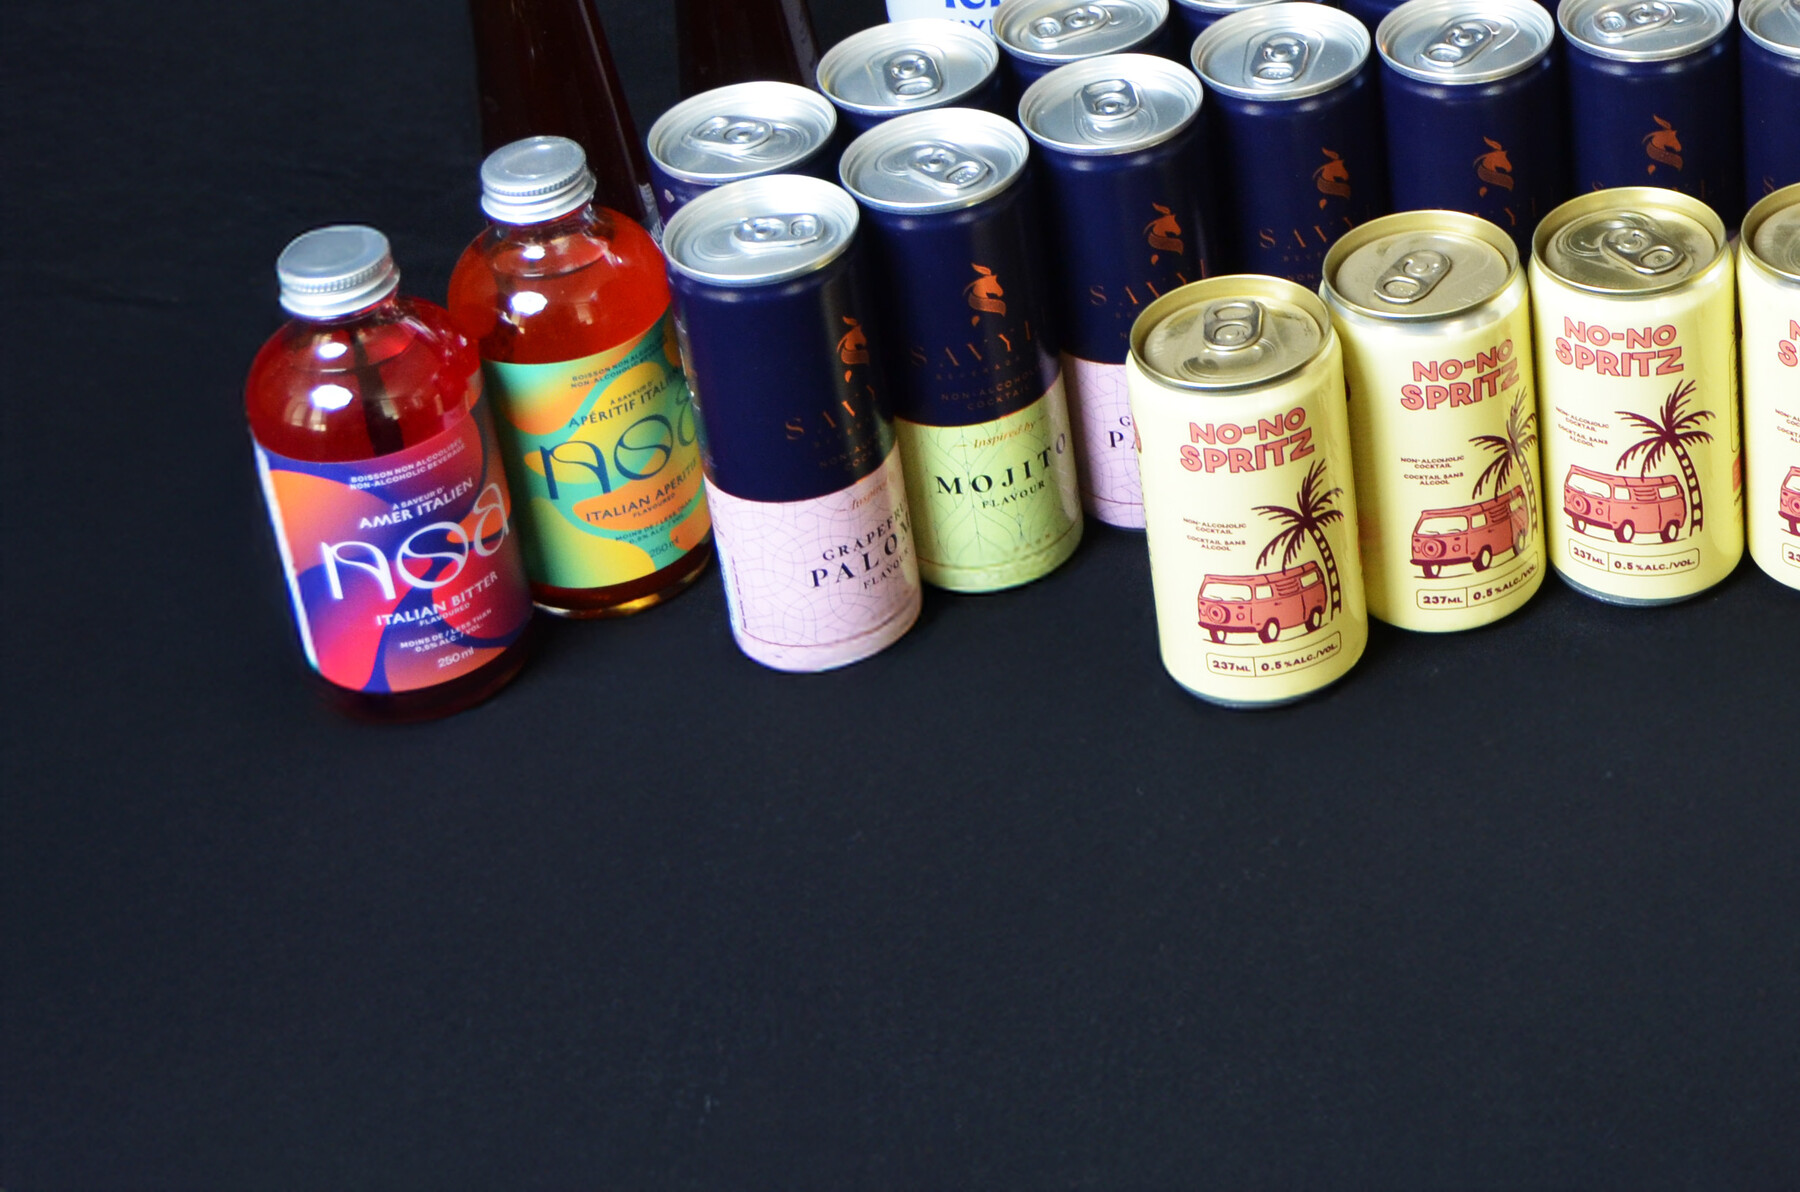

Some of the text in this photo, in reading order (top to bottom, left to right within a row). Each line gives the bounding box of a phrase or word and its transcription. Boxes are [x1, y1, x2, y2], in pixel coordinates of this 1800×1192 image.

[1564, 316, 1677, 348] NO-NO
[1412, 339, 1513, 382] NO-NO
[1555, 337, 1684, 377] SPRITZ
[1401, 357, 1519, 410] SPRITZ
[569, 399, 636, 428] APÉRITIF
[1189, 407, 1306, 445] NO-NO
[973, 424, 1021, 449] Inspired
[1180, 427, 1315, 473] SPRITZ
[350, 469, 393, 483] BOISSON
[395, 464, 415, 474] NON
[935, 432, 1066, 495] MOJITO
[349, 467, 426, 490] NON-ALCOHOLIC
[359, 477, 474, 529] AMER ITALIEN
[400, 492, 436, 508] SAVEUR
[586, 495, 651, 522] ITALIAN
[982, 480, 1046, 509] FLAVOUR
[1573, 546, 1605, 565] 237ML
[376, 570, 498, 626] ITALIAN BITTER
[1423, 595, 1463, 604] 237ML
[419, 601, 471, 627] FLAVOURED
[400, 608, 492, 650] MOINS DE LESS THAN
[1212, 659, 1251, 672] 237ML
